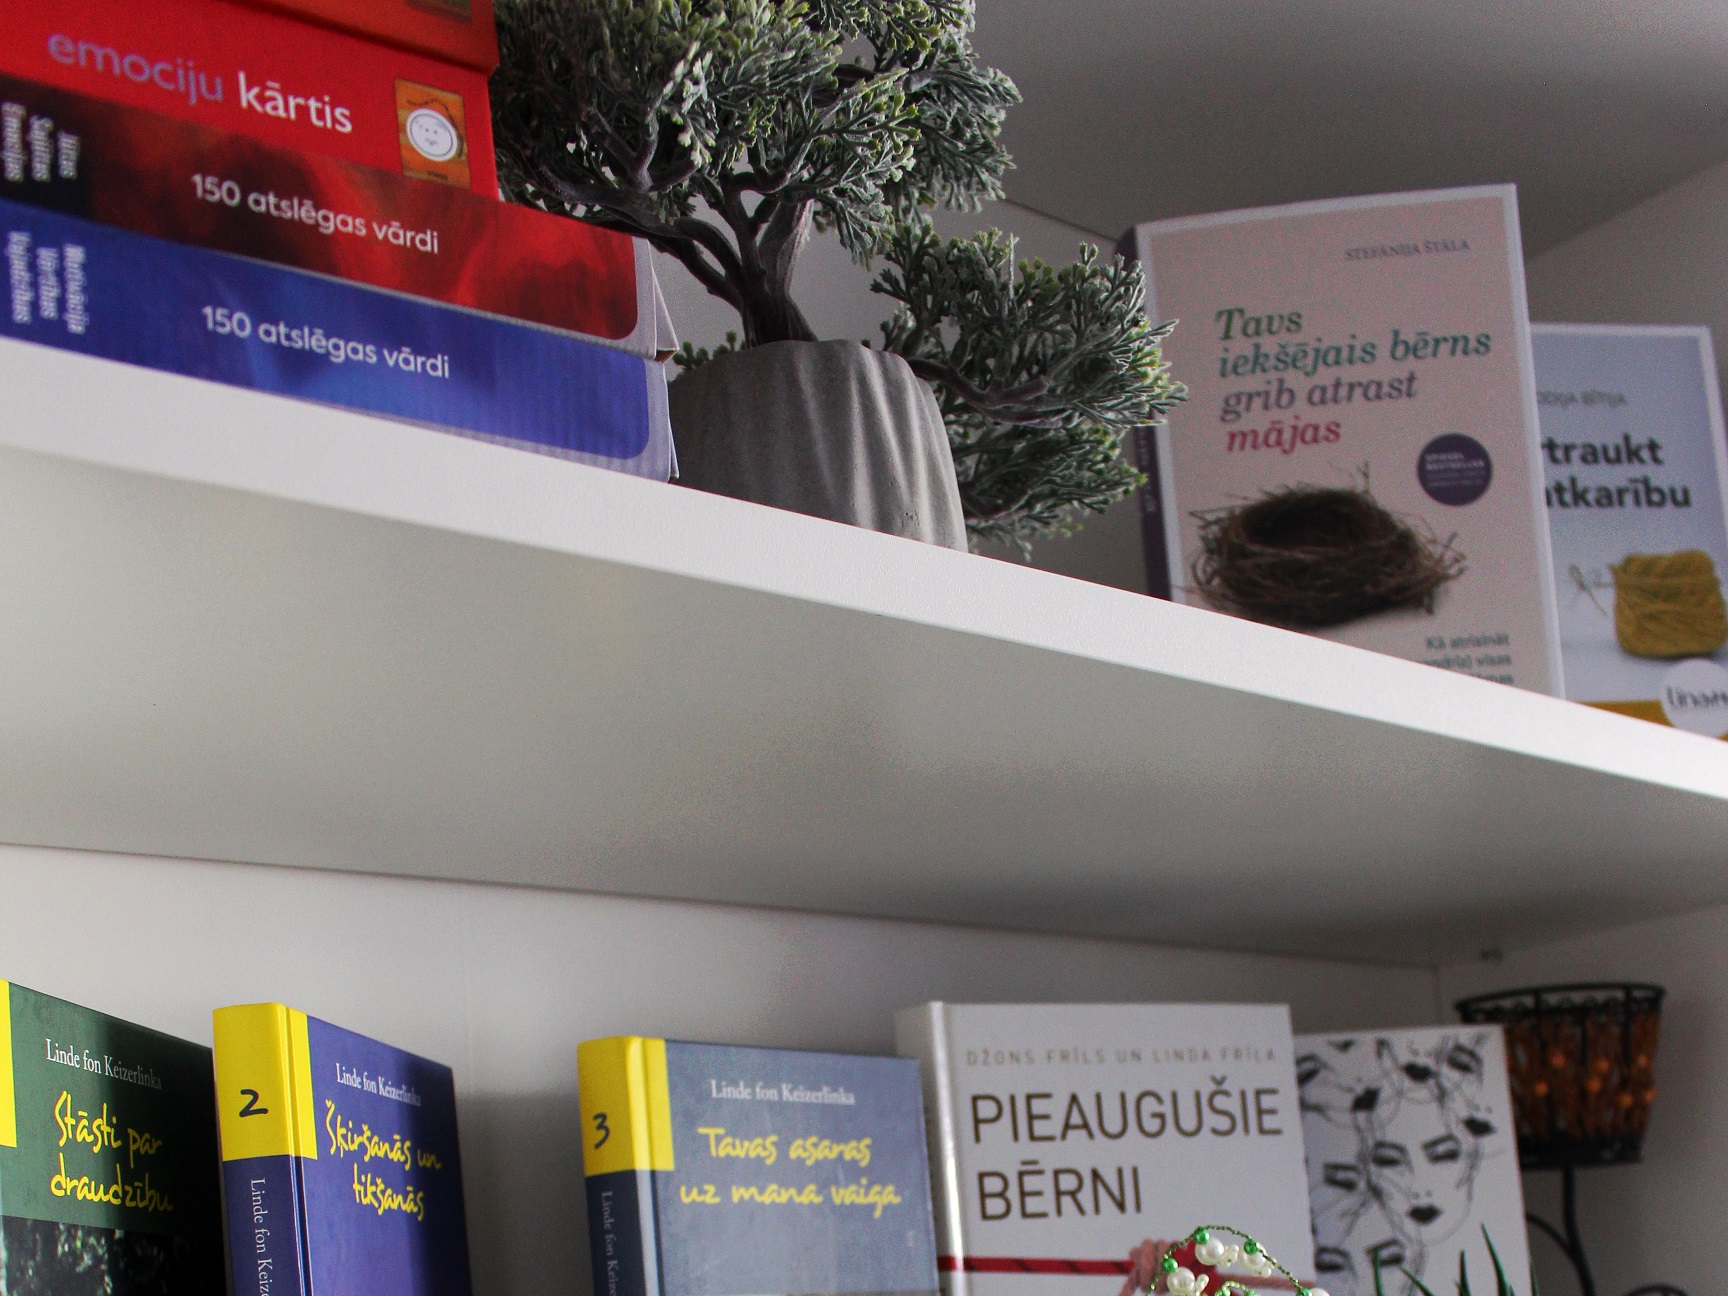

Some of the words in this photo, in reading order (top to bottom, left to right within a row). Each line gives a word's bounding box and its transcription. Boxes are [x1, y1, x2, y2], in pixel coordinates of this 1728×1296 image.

[48, 32, 224, 105] emociju
[237, 71, 353, 134] kārtis
[191, 173, 241, 208] 150
[247, 186, 368, 239] atslēgas
[372, 219, 439, 254] vārdi
[202, 305, 252, 338] 150
[257, 318, 378, 364] atslēgas
[382, 346, 450, 379] vārdi
[1216, 307, 1303, 342] Tavs
[1218, 333, 1378, 379] iekšējais
[1390, 328, 1492, 362] bērns
[1220, 377, 1296, 423] grib
[1307, 370, 1418, 409] atrast
[1226, 417, 1342, 458] mājas
[1541, 432, 1665, 466] traukt
[46, 1038, 80, 1068] Linde
[83, 1050, 101, 1074] fon
[104, 1055, 162, 1090] Keizerlinka
[967, 1046, 1036, 1068] DŽONS
[1047, 1046, 1105, 1066] FRĪLS
[1117, 1049, 1142, 1065] UN
[1153, 1048, 1211, 1065] LINDA
[239, 1089, 268, 1118] 2
[336, 1063, 361, 1089] Linde
[363, 1072, 377, 1094] fon
[378, 1076, 422, 1107] Keizerlinka
[711, 1079, 751, 1099] Linde
[755, 1081, 778, 1101] fon
[782, 1082, 855, 1105] Keizerlinka
[54, 1090, 122, 1154] Stāsti
[127, 1128, 163, 1169] par
[591, 1111, 609, 1150] 3
[971, 1075, 1283, 1144] PIEAUGUŠIE
[325, 1099, 411, 1171] Šķiršanās
[417, 1149, 441, 1169] un
[697, 1127, 778, 1165] Tavas
[789, 1136, 872, 1167] asaras
[51, 1152, 174, 1212] draudzību
[250, 1178, 267, 1222] Linde
[353, 1163, 424, 1222] tikšanās
[679, 1184, 720, 1205] uz
[731, 1183, 823, 1205] mana
[830, 1176, 901, 1219] vaiga
[977, 1160, 1142, 1221] BĒRNI
[600, 1190, 615, 1232] Linde
[255, 1225, 268, 1254] fon
[605, 1234, 618, 1257] fon
